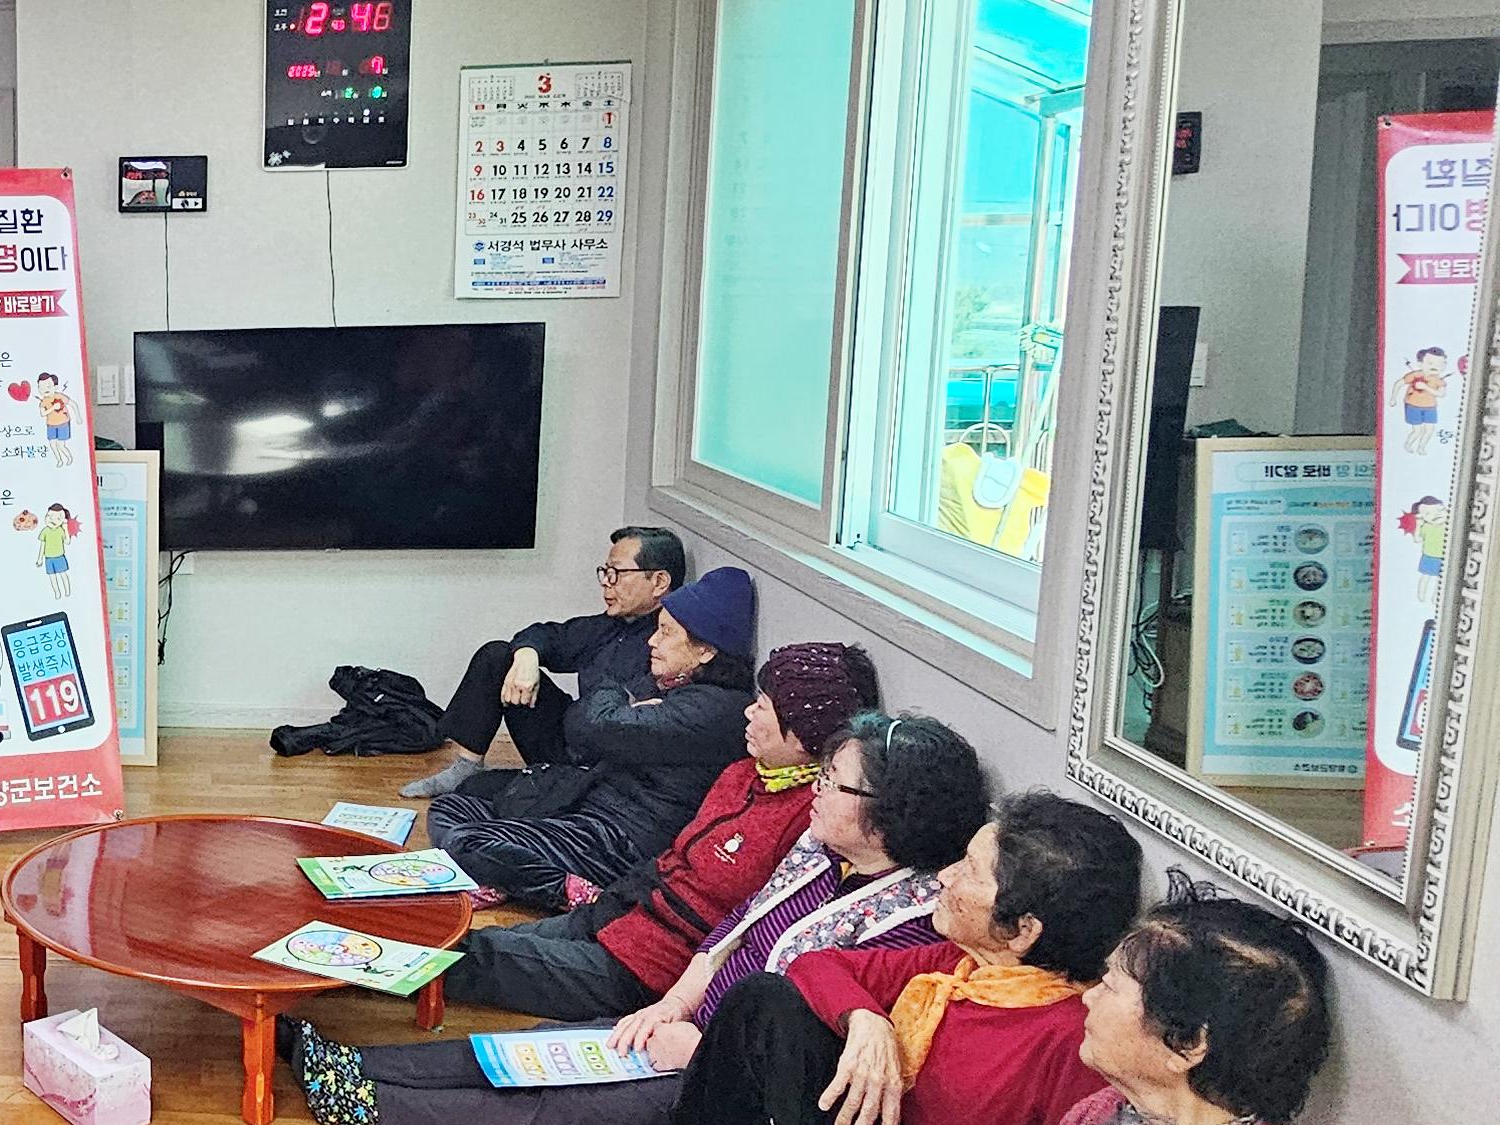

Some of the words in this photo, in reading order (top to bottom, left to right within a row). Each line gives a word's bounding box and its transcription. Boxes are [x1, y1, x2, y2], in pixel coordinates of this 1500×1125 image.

[537, 73, 552, 94] 3
[475, 141, 483, 152] 2
[496, 140, 505, 152] 3
[517, 139, 525, 151] 4
[538, 139, 547, 150] 5
[560, 138, 568, 150] 6
[582, 137, 590, 149] 7
[603, 136, 612, 148] 8
[474, 165, 482, 176] 9
[493, 164, 507, 176] 10
[514, 164, 527, 175] 11
[534, 163, 550, 175] 12
[556, 163, 571, 174] 13
[577, 162, 592, 174] 14
[598, 161, 614, 173] 15
[470, 189, 485, 200] 16
[491, 188, 506, 200] 17
[512, 188, 527, 199] 18
[534, 187, 549, 199] 19
[554, 187, 571, 198] 20
[577, 186, 592, 198] 21
[597, 186, 614, 198] 22
[510, 212, 527, 224] 25
[532, 211, 549, 223] 26
[553, 211, 570, 223] 27
[575, 210, 592, 222] 28
[596, 210, 613, 222] 29
[488, 240, 524, 252] 서경석
[529, 239, 566, 251] 법무사
[570, 238, 609, 250] 사무소
[4, 295, 55, 314] 바로알기
[13, 630, 68, 659] 응급증상
[17, 654, 74, 682] 발생즉시
[29, 680, 80, 722] 119
